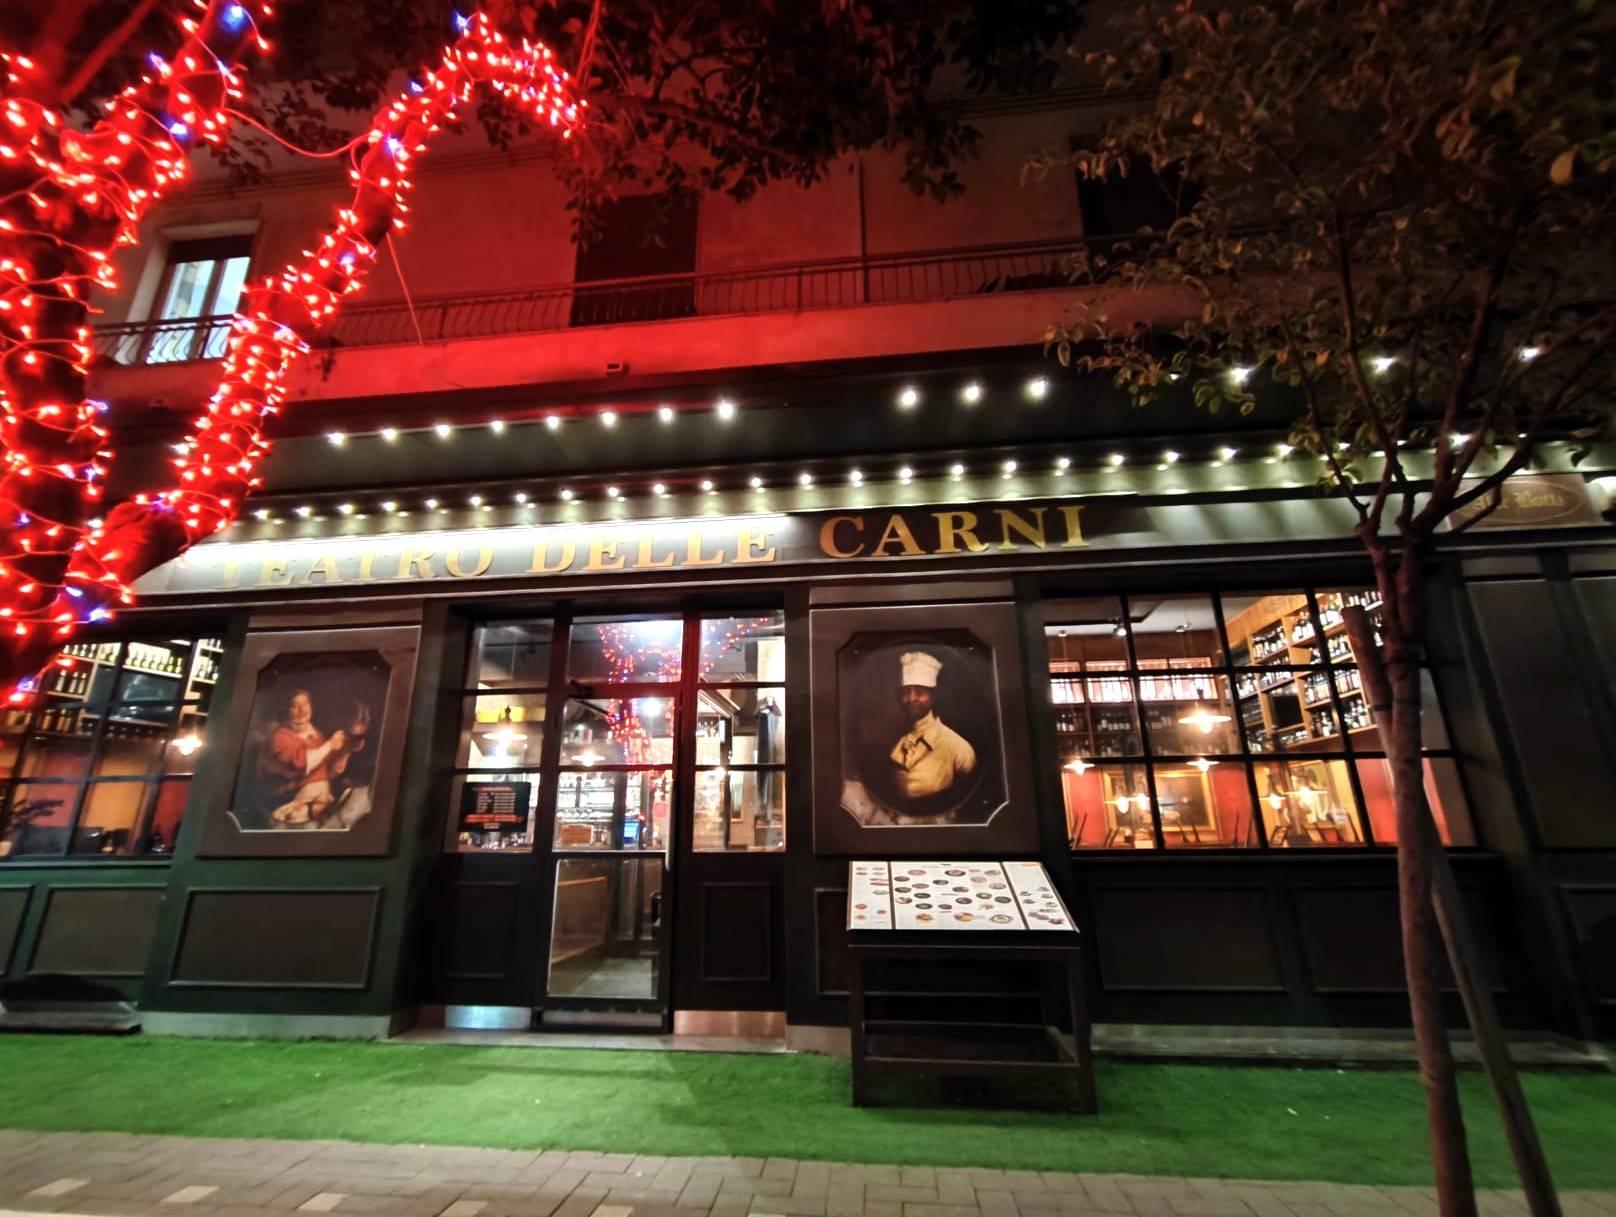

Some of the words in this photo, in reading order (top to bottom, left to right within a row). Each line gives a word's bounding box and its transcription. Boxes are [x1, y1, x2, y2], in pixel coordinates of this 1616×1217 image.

[212, 540, 496, 589] TEATRO
[525, 527, 778, 574] DELLE
[818, 505, 1091, 558] CARNI
